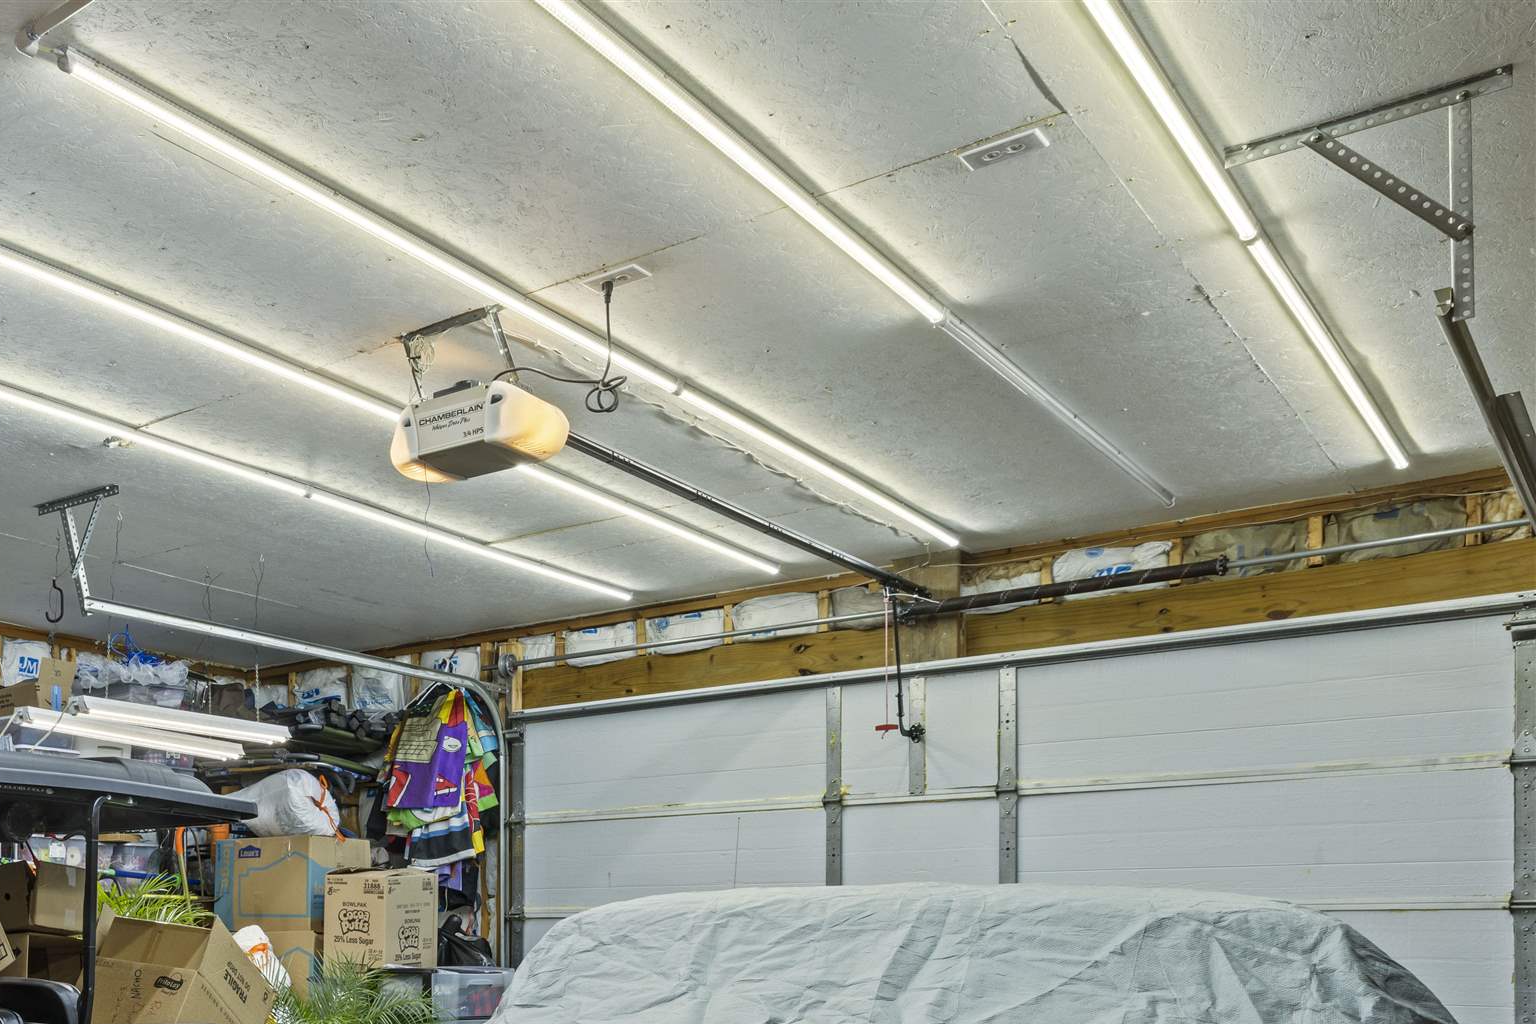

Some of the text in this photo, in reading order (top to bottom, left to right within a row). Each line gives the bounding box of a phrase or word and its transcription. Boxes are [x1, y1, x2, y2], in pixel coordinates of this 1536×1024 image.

[419, 403, 484, 425] CHAMBERLAIN
[19, 656, 39, 676] JM
[338, 908, 370, 921] Cocoa
[340, 919, 370, 935] Puffs
[398, 926, 419, 939] Cocoa
[346, 936, 358, 944] Less
[359, 937, 374, 946] Sugar
[399, 938, 419, 953] Puffs
[224, 969, 247, 1004] FRAGILE
